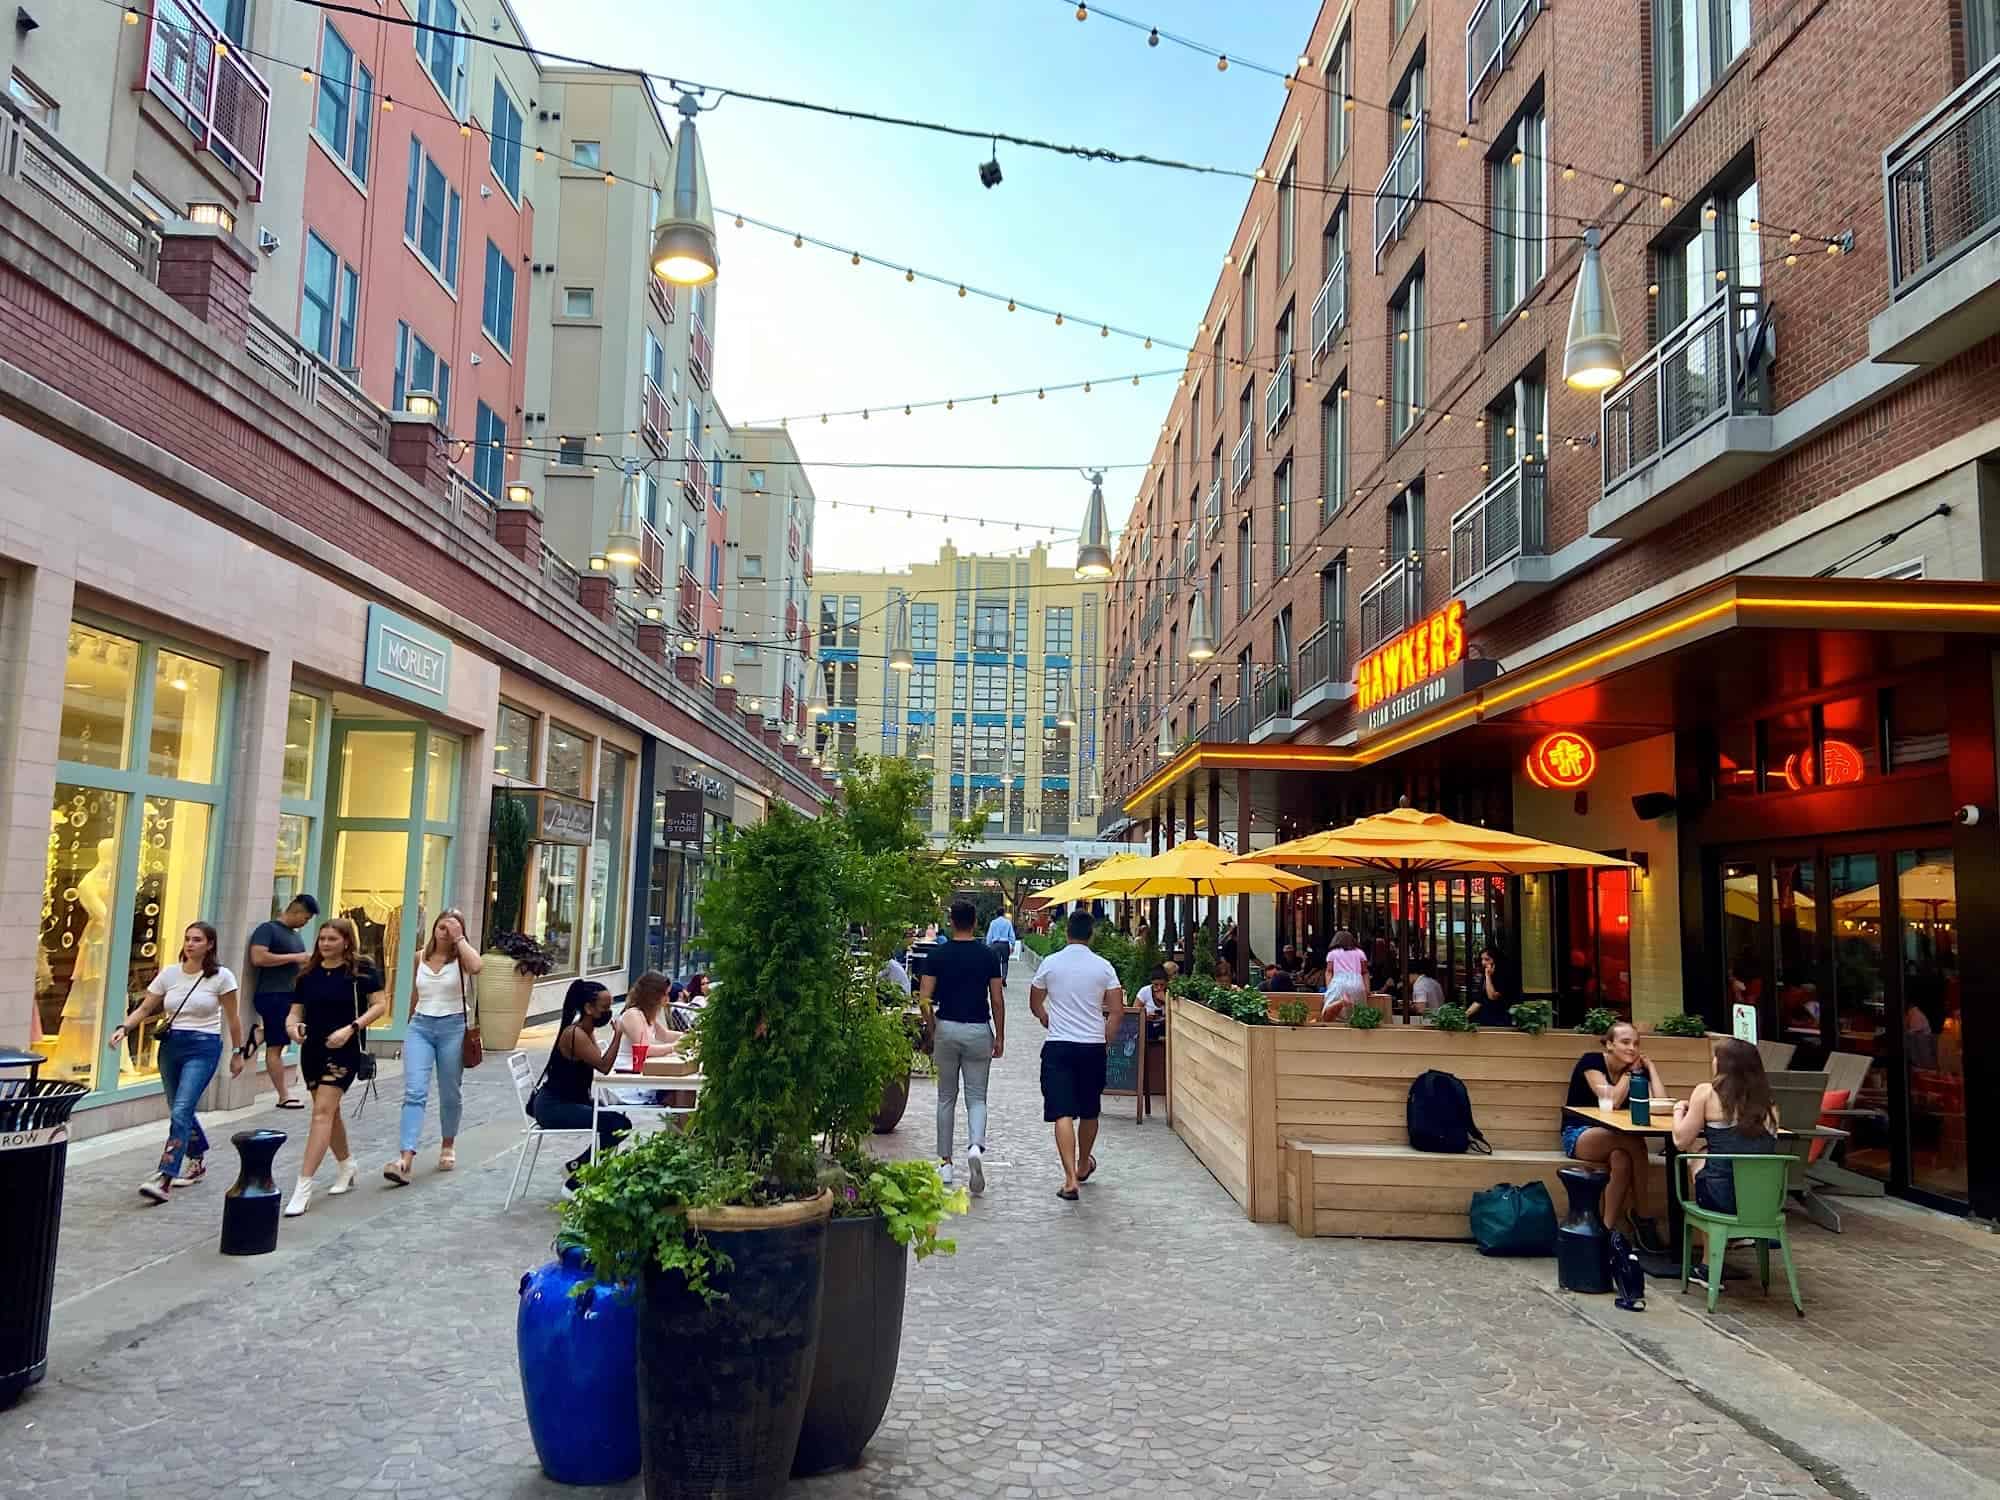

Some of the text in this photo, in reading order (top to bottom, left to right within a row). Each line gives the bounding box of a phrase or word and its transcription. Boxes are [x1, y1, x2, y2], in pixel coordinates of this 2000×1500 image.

[388, 640, 439, 681] MORLEY
[1358, 600, 1464, 712] HAWKERS
[1368, 677, 1446, 729] ASIAN STREET FOOD
[2, 1133, 38, 1146] ROW
